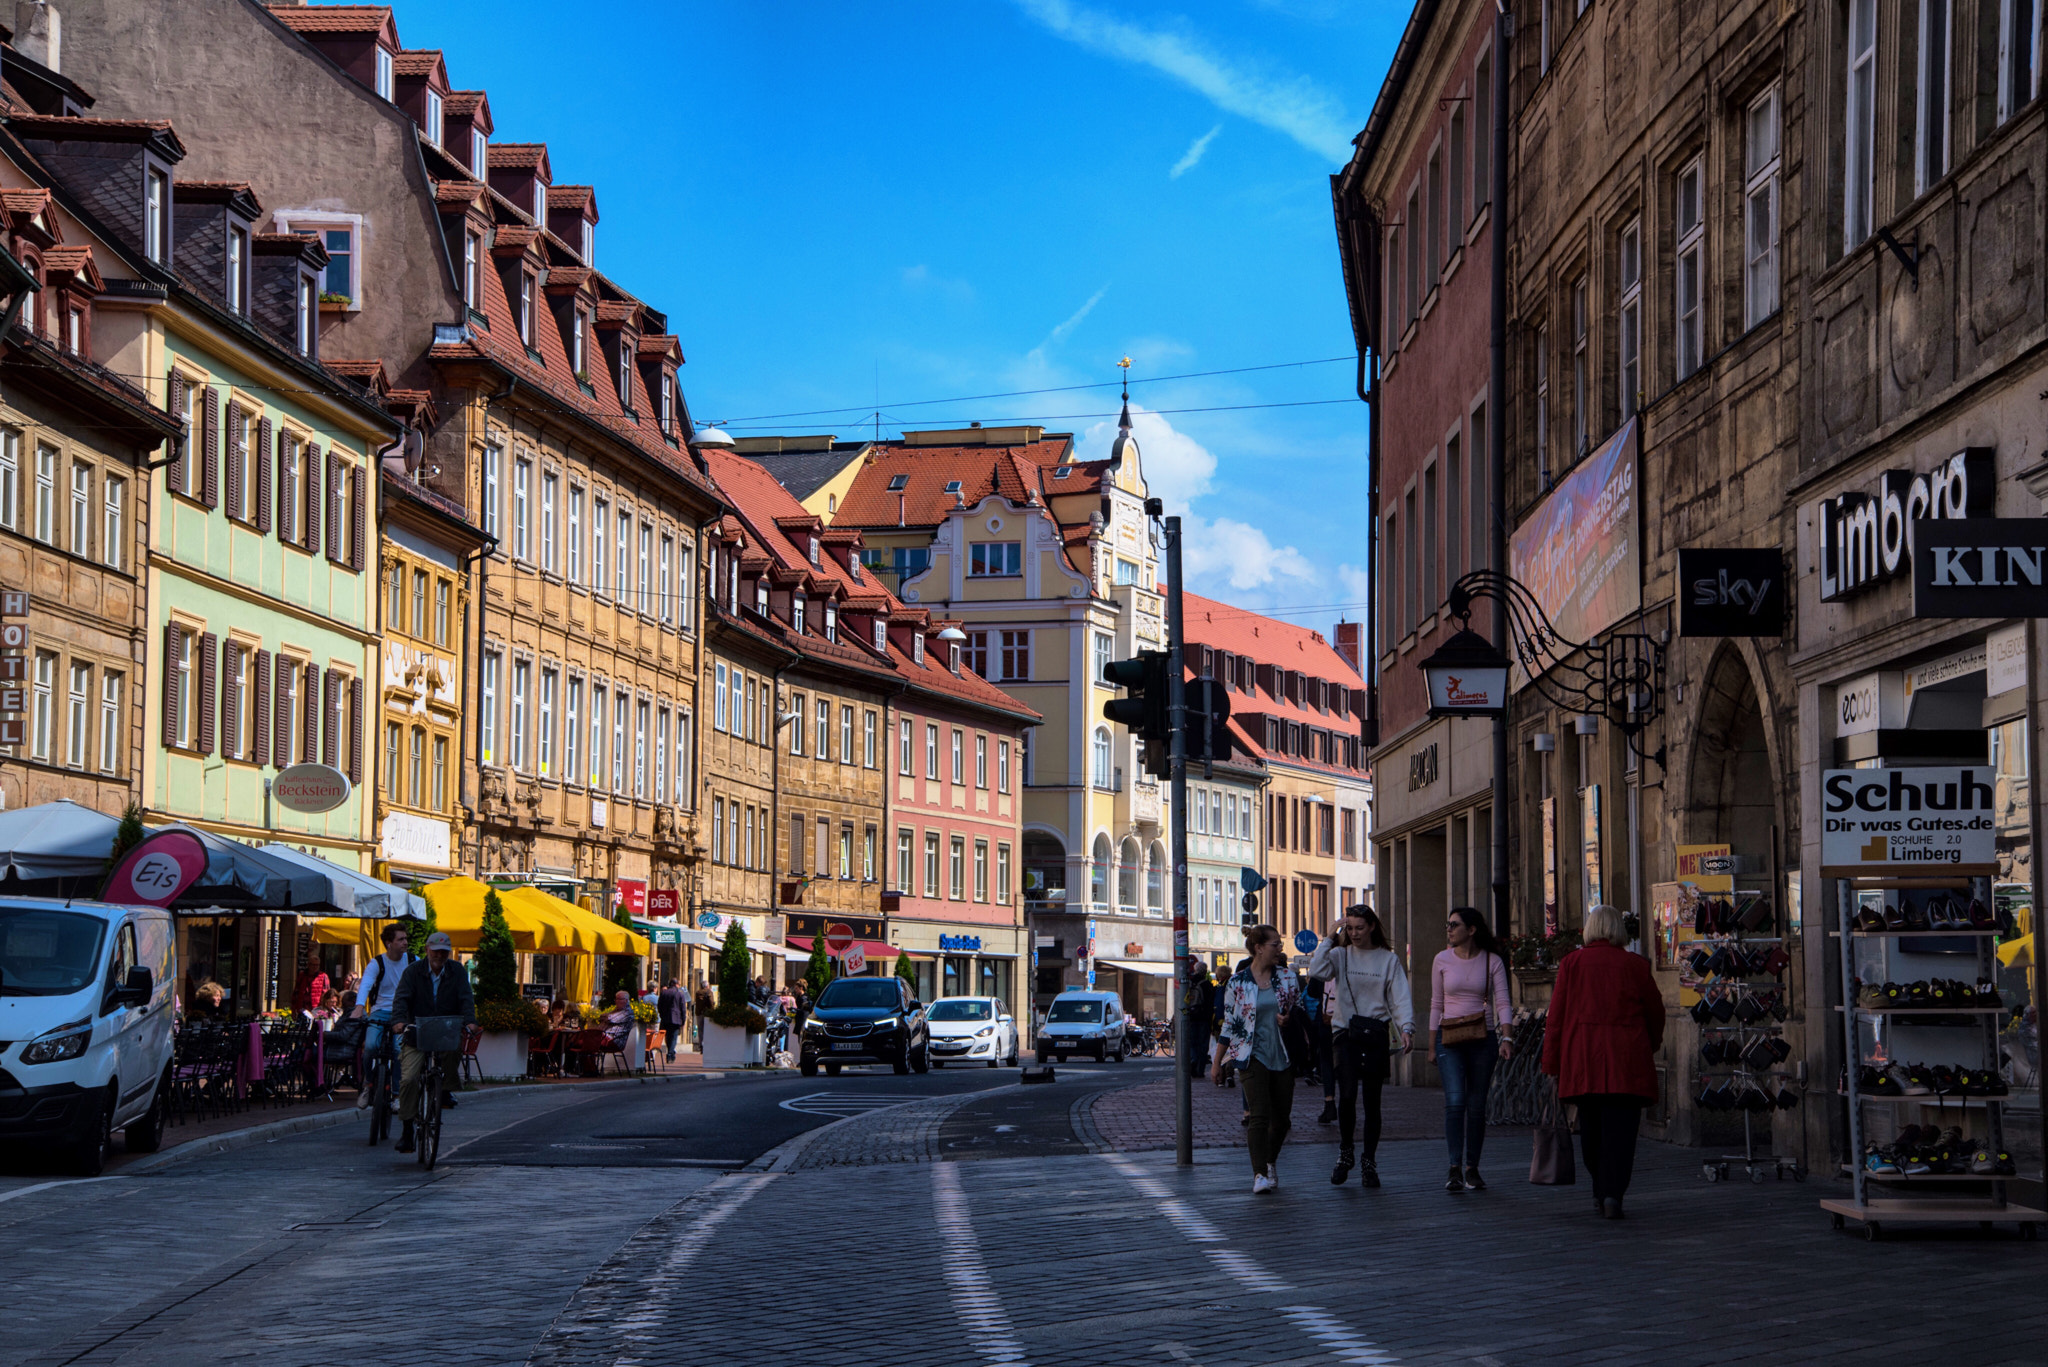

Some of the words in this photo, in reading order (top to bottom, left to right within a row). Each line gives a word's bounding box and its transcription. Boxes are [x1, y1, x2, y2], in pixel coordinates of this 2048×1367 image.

[1575, 461, 1632, 552] DONNERSTAG
[1930, 546, 2047, 586] KIN
[1693, 568, 1771, 615] sky
[2, 594, 23, 742] HOTEL
[1842, 687, 1872, 724] ecco
[278, 784, 340, 797] Beckstein
[1826, 770, 1993, 812] Schuh
[1826, 817, 1856, 832] Dir
[1861, 820, 1902, 832] was
[1907, 815, 1993, 831] Gutes.de
[1890, 835, 1934, 845] SCHUHE
[1947, 834, 1962, 845] 2.0
[1705, 860, 1731, 869] MOON
[1891, 847, 1961, 864] Limberg
[135, 861, 178, 888] Eis
[650, 897, 673, 909] DER
